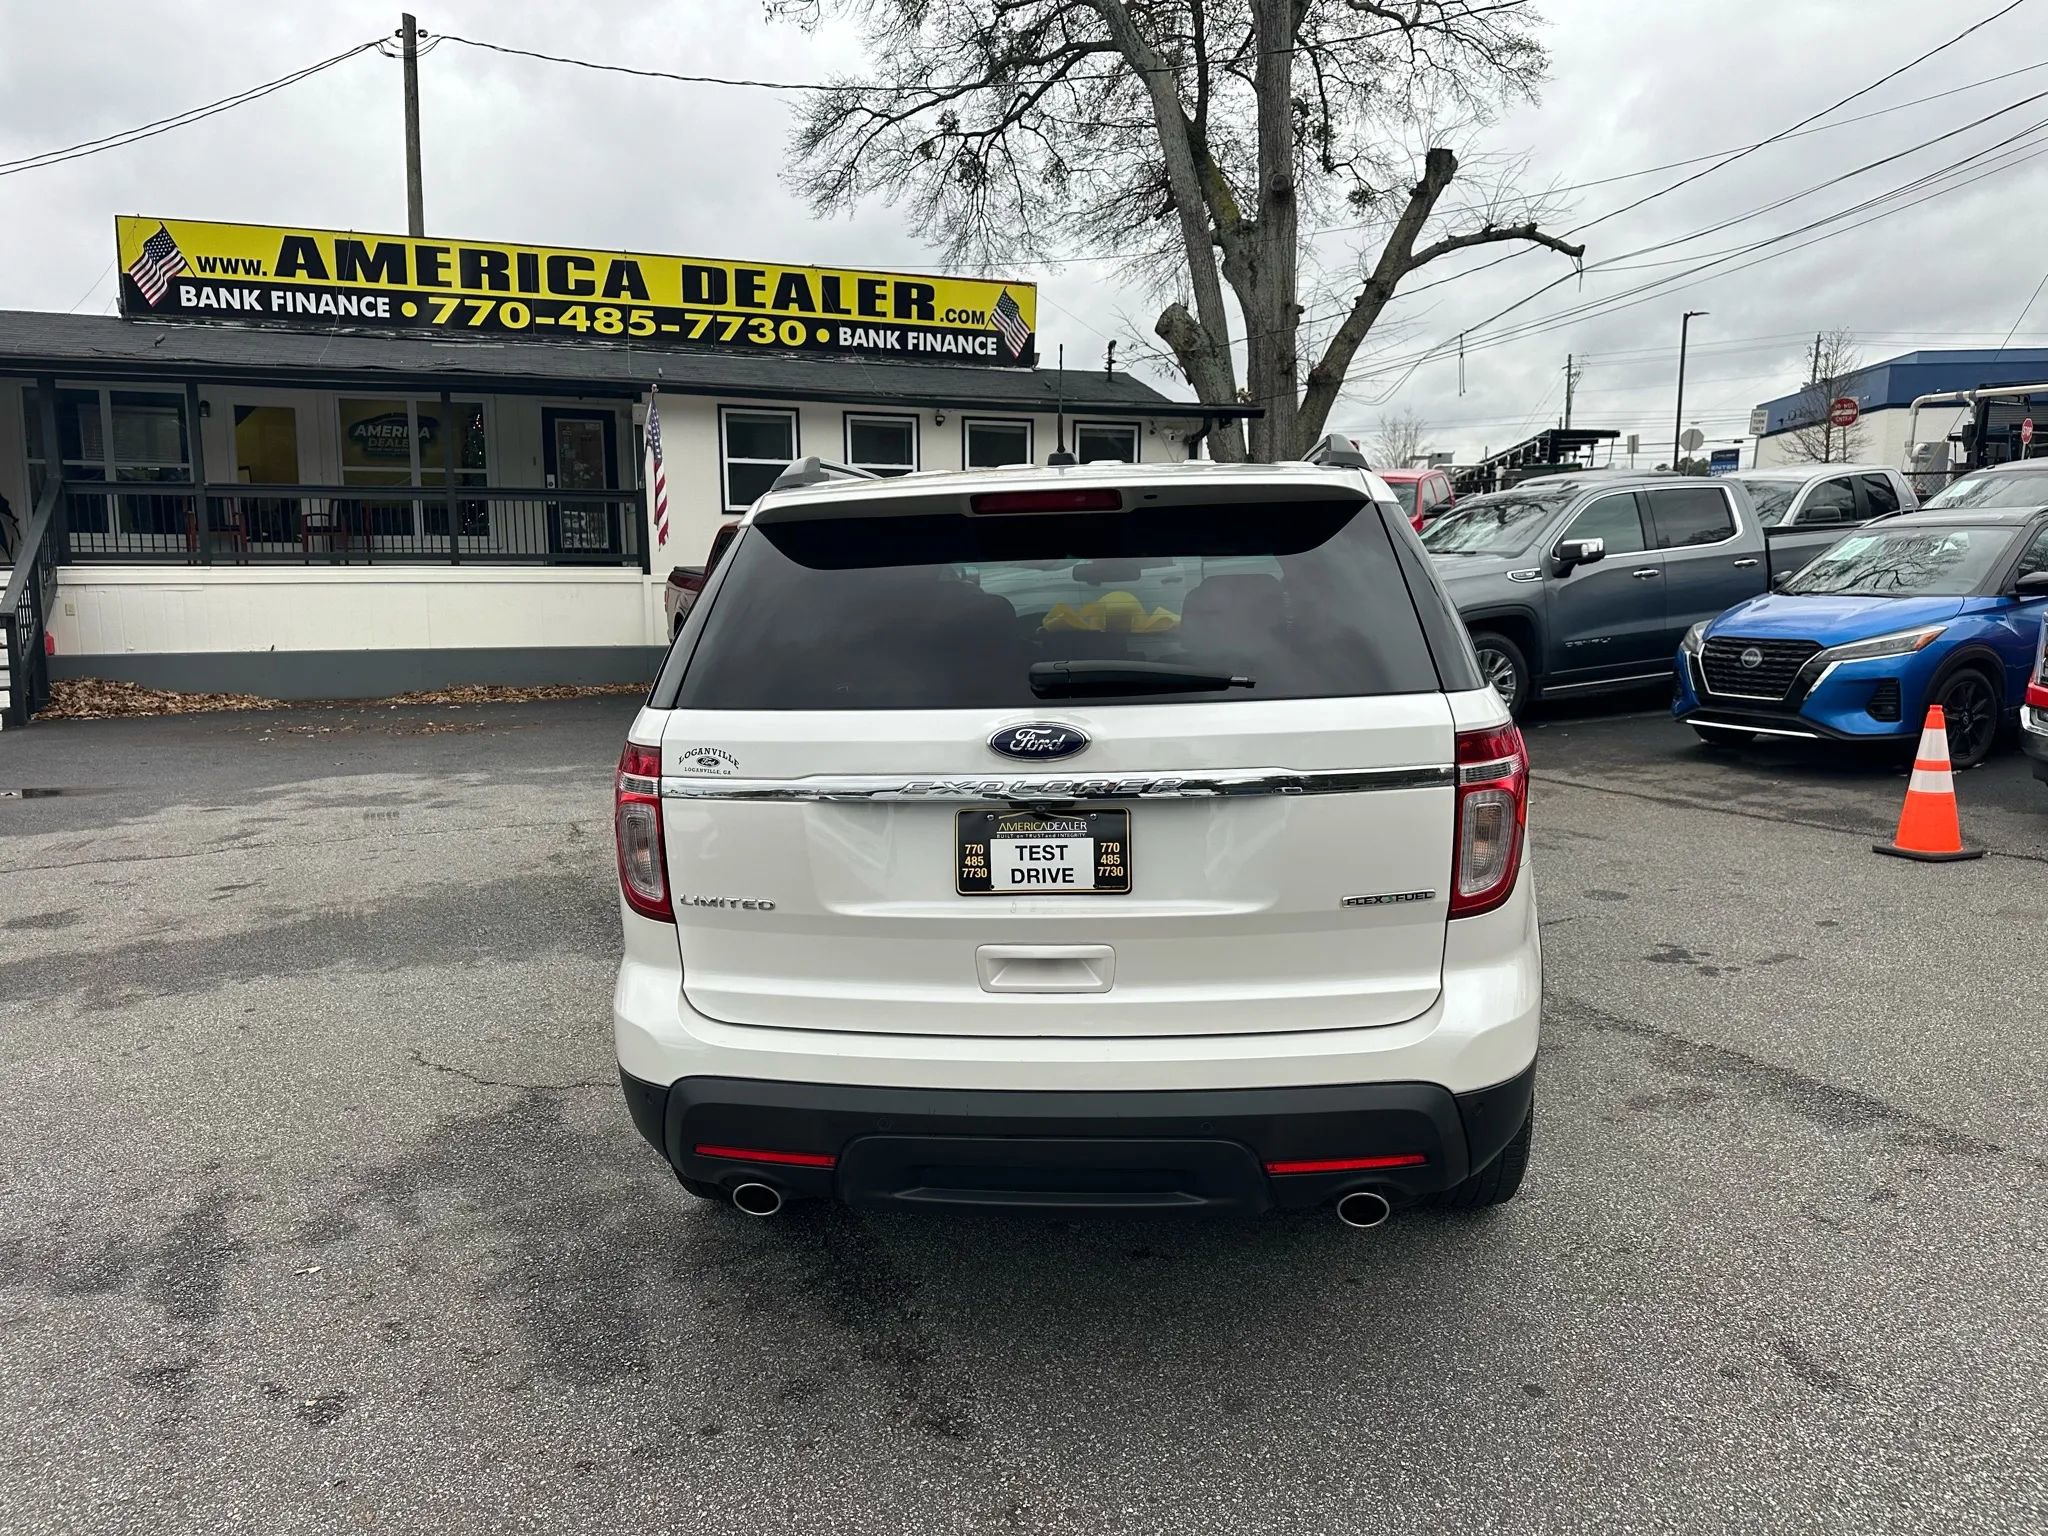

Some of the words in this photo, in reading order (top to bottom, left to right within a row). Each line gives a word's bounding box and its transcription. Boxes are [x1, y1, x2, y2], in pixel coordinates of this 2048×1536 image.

[273, 235, 651, 300] AMERICA
[681, 264, 936, 321] DEALER
[939, 308, 986, 326] .COM
[179, 285, 262, 312] BANK
[271, 290, 391, 318] FINANCE
[428, 297, 807, 346] 770-485-7730
[838, 326, 902, 350] BANK
[906, 331, 998, 356] FINANCE
[354, 425, 430, 439] AMERIA
[368, 438, 409, 448] DEALE
[1010, 728, 1066, 751] Ford
[678, 747, 740, 770] LOGANVILLE
[900, 778, 1183, 796] EXPLORER
[965, 844, 984, 855] 770
[1015, 844, 1069, 861] TEST
[1100, 842, 1120, 853] 770
[965, 856, 985, 867] 485
[1100, 854, 1121, 865] 485
[962, 867, 988, 879] 7730
[1011, 867, 1075, 884] DRIVE
[1097, 866, 1124, 877] 7730
[680, 894, 776, 911] LIMITED
[1346, 896, 1383, 906] FLEX
[1396, 892, 1433, 902] FUEL
